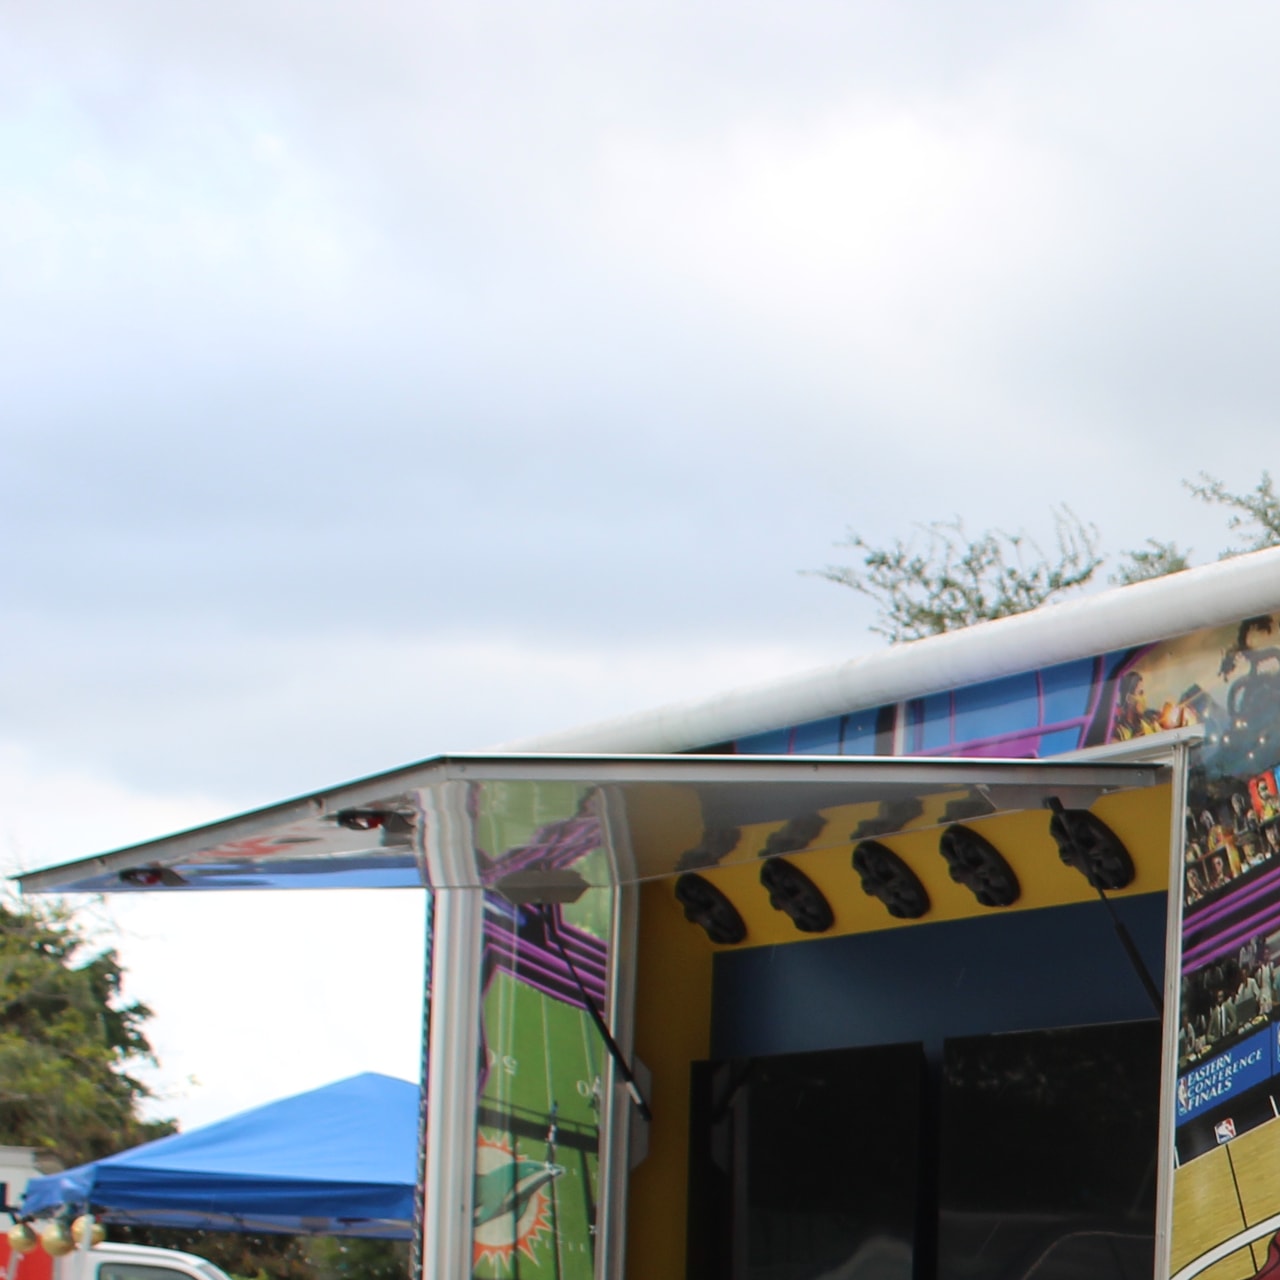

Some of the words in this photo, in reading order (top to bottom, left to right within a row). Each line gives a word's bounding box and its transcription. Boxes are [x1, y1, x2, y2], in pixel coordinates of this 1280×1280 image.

[1187, 1047, 1262, 1097] CONFERENCE
[1188, 1052, 1232, 1086] EASTERN
[1187, 1077, 1232, 1111] FINALS
